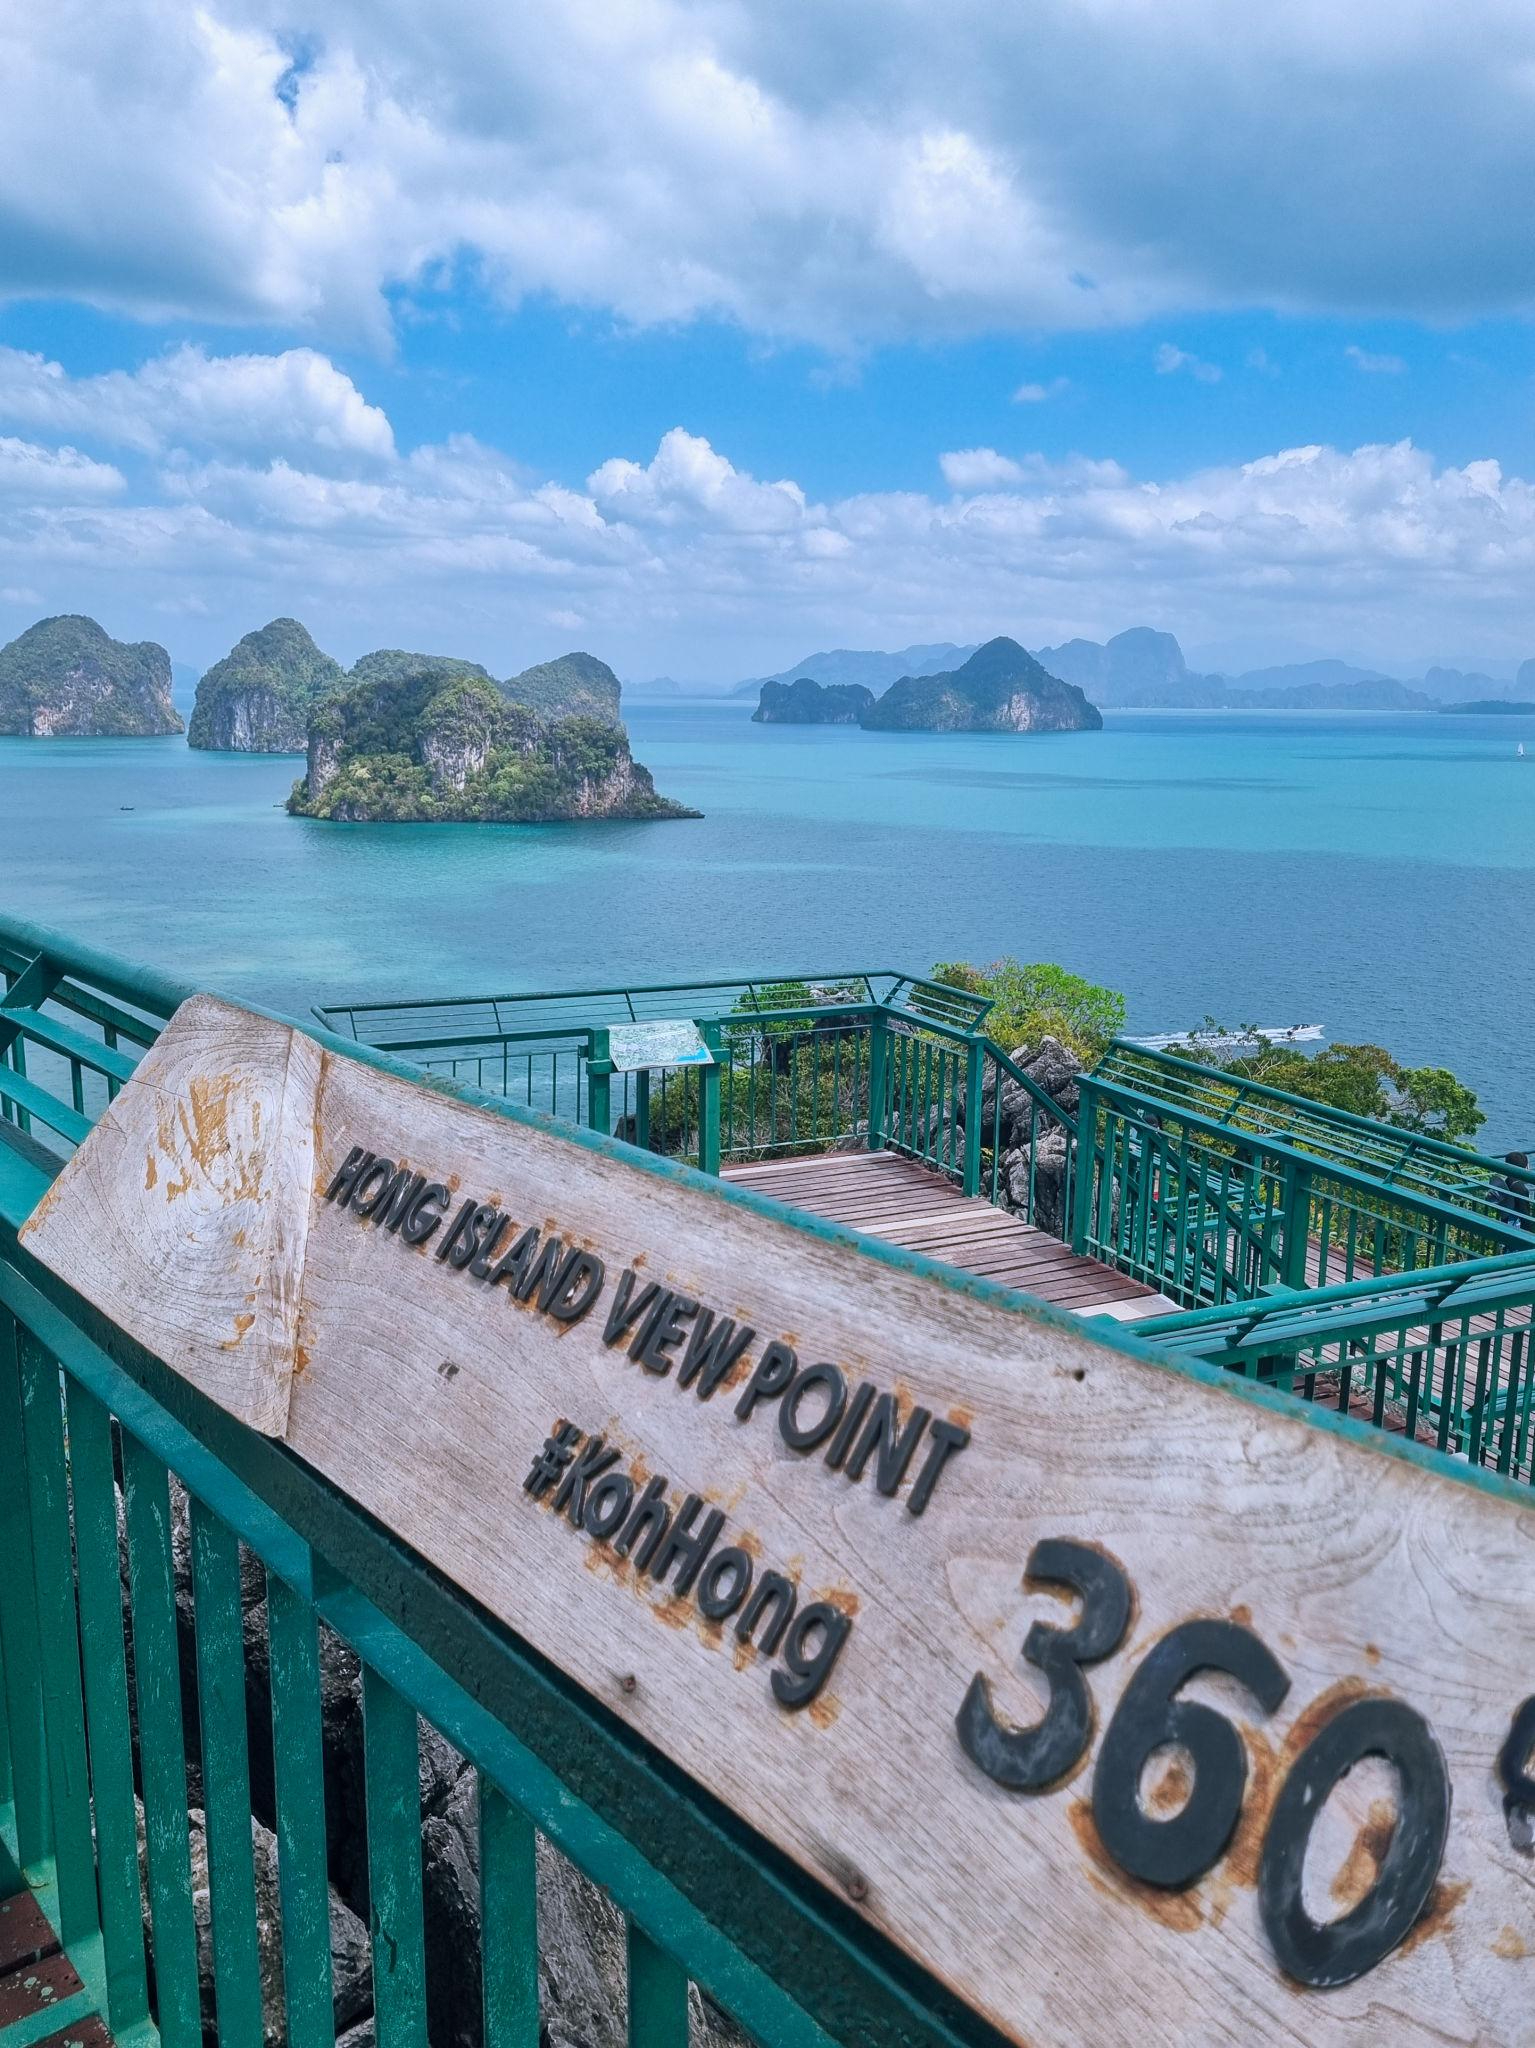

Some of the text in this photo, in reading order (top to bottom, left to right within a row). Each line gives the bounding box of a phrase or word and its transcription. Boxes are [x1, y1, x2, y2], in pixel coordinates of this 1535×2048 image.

[323, 1146, 971, 1515] HONG ISLAND VIEW POINT
[522, 1418, 853, 1710] #KohHong
[955, 1538, 1453, 1989] 360
